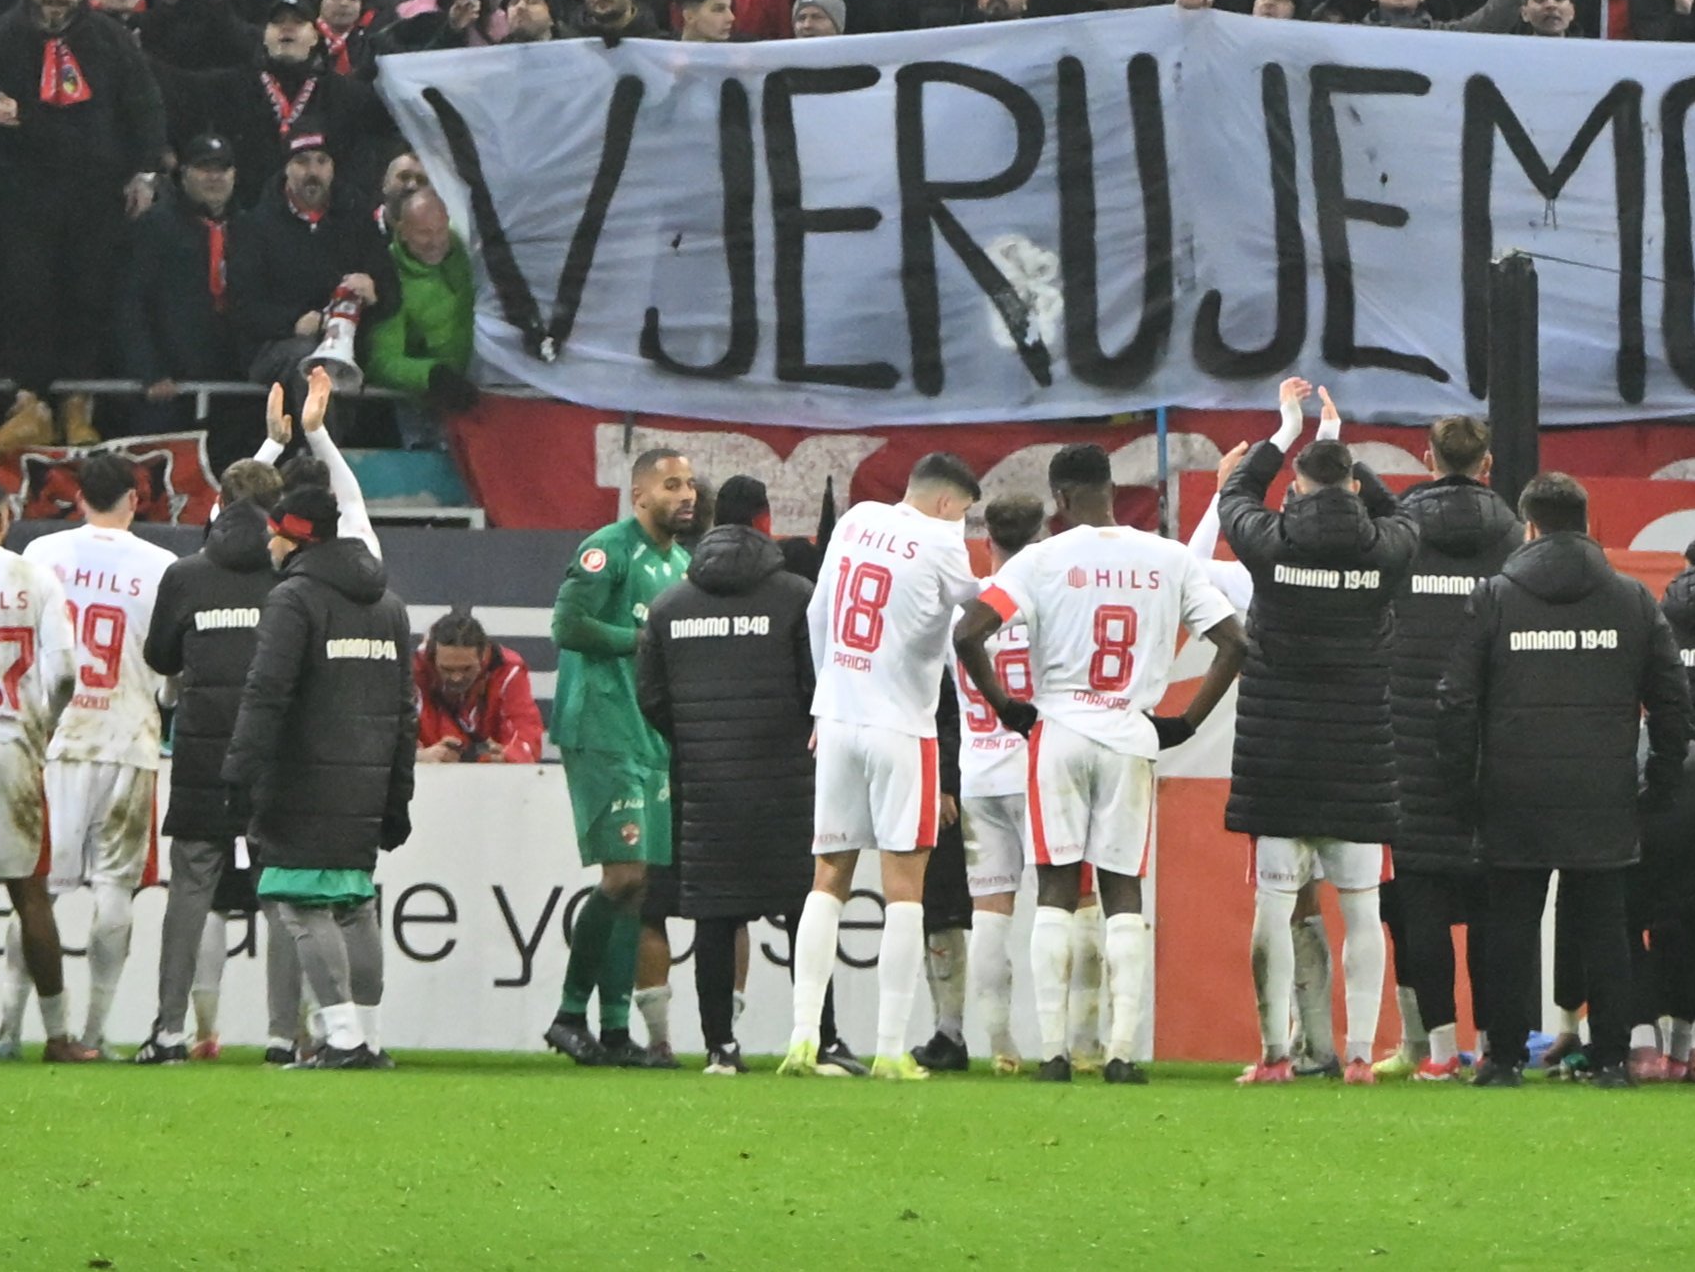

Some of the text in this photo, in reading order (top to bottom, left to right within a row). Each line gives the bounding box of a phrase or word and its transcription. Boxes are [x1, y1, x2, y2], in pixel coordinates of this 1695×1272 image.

[857, 528, 920, 560] HILS
[74, 568, 142, 597] HILS
[1095, 568, 1160, 590] HILS
[1273, 564, 1381, 590] DINAMO 1948
[1411, 574, 1474, 596] DINAMO
[833, 555, 893, 654] 18
[194, 608, 261, 631] DINAMO
[670, 615, 770, 639] DINAMO 1948
[1088, 603, 1138, 692] 8
[1509, 629, 1618, 652] DINAMO 1948
